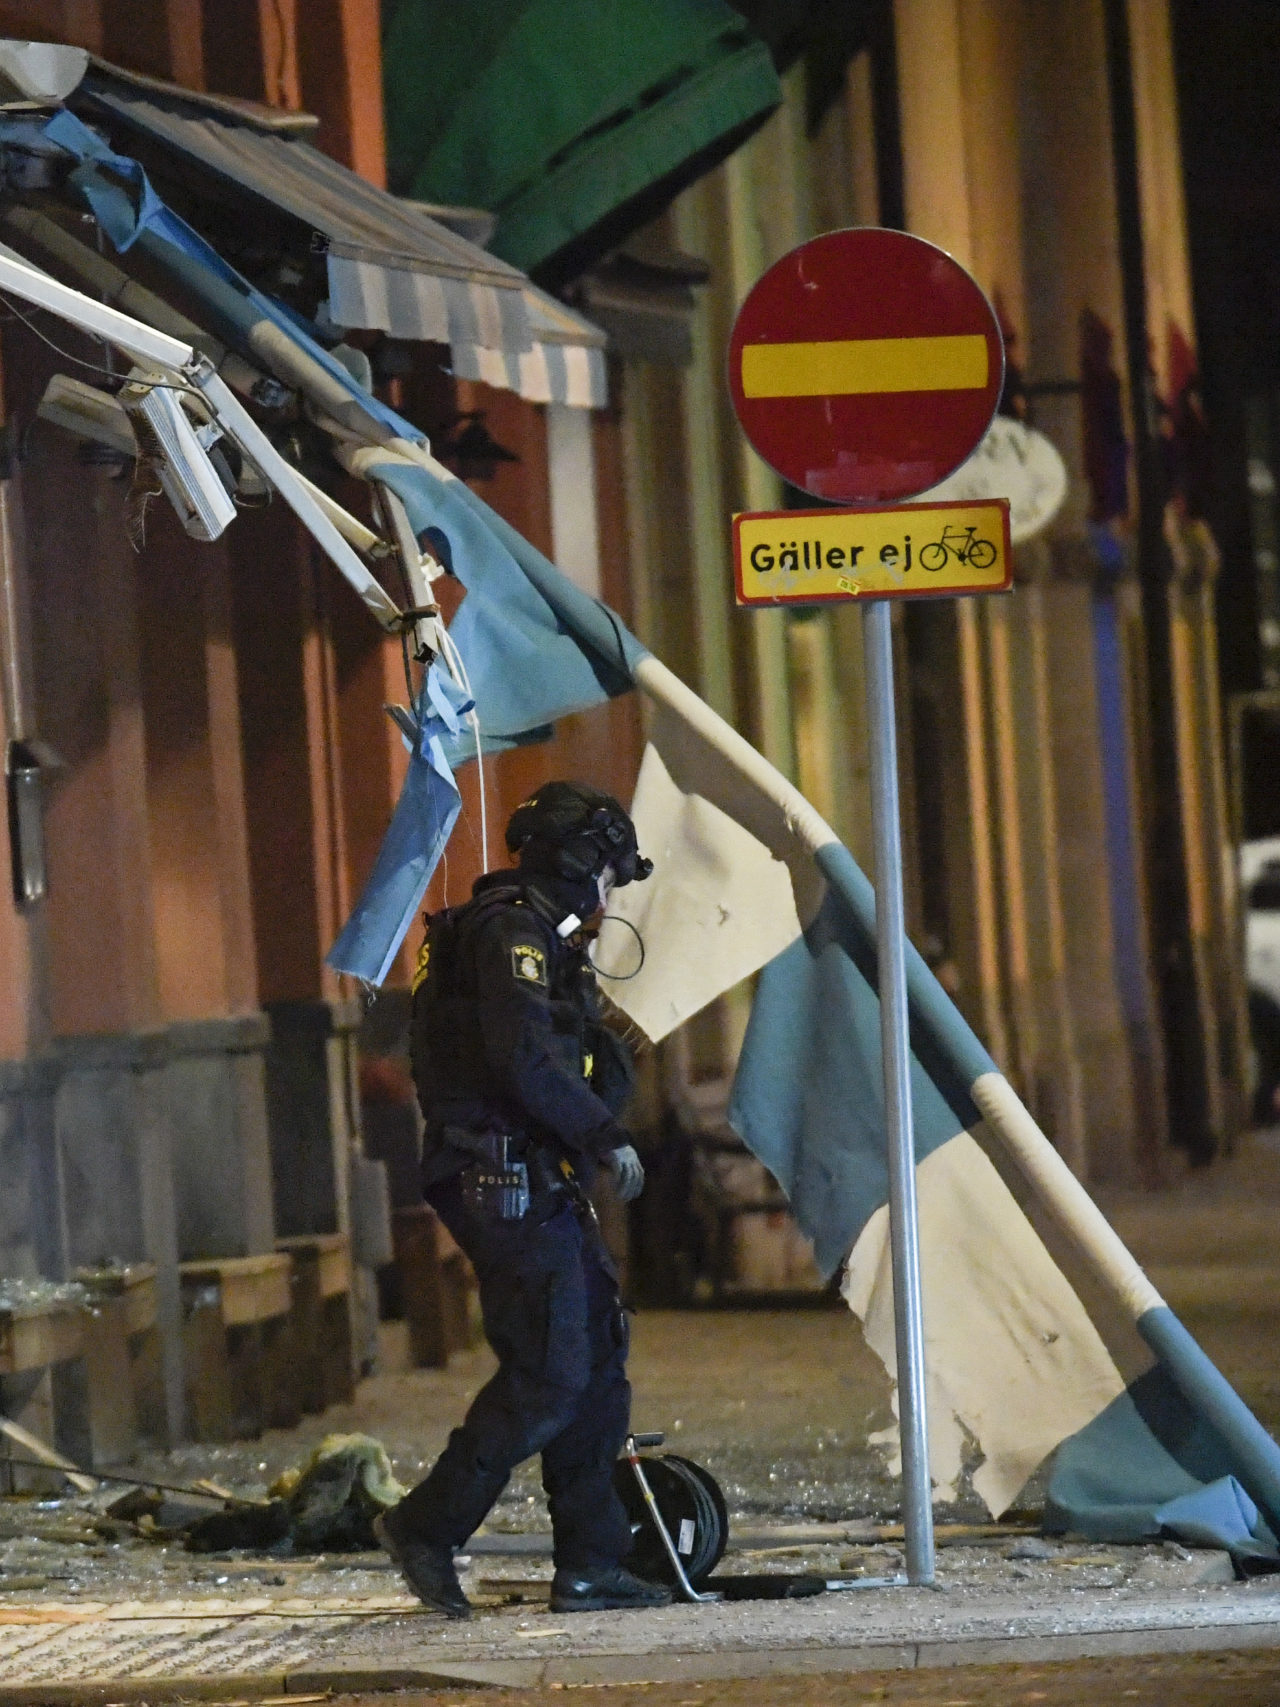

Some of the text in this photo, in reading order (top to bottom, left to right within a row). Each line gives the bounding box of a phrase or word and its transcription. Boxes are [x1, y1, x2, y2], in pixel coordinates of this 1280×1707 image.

[750, 535, 912, 573] Gäller ej
[479, 1175, 519, 1185] POLIS
